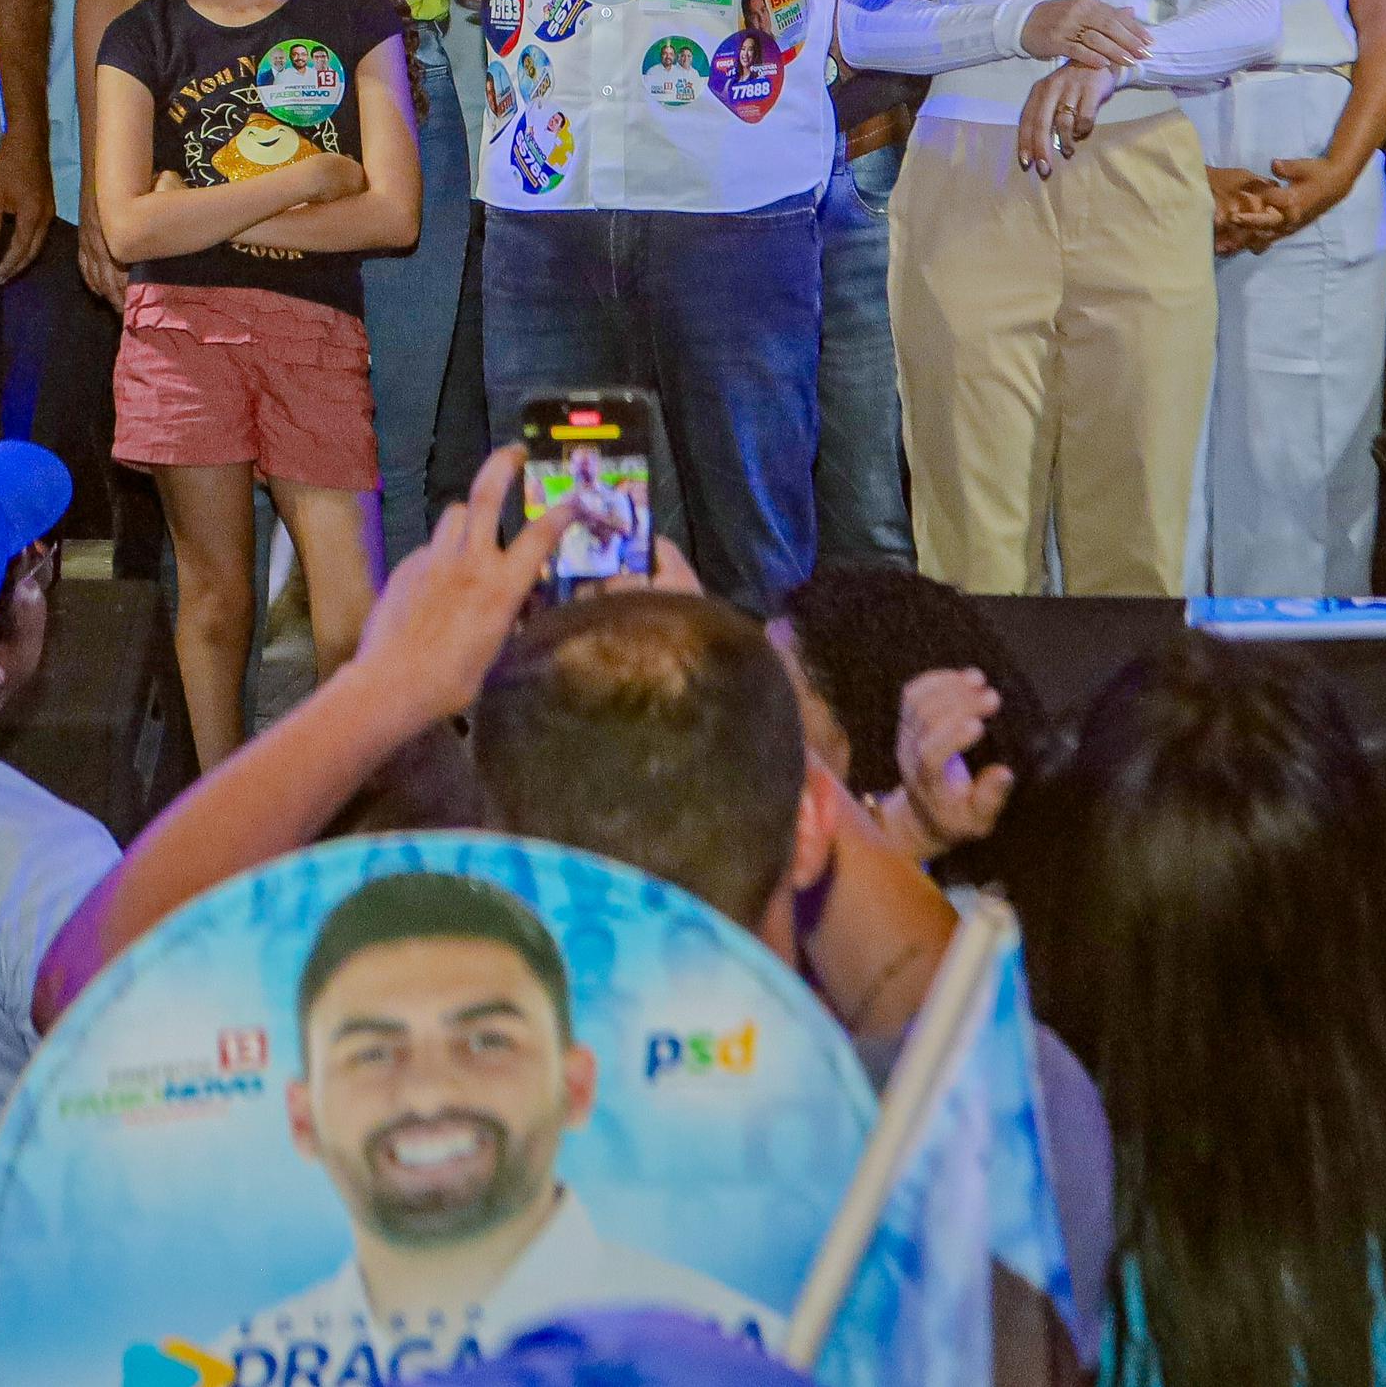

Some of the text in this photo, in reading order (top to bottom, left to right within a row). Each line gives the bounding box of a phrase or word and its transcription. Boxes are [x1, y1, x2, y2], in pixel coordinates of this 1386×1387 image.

[318, 71, 334, 86] 13
[731, 81, 771, 100] 77888
[515, 129, 550, 187] 55789
[644, 1017, 760, 1082] psd
